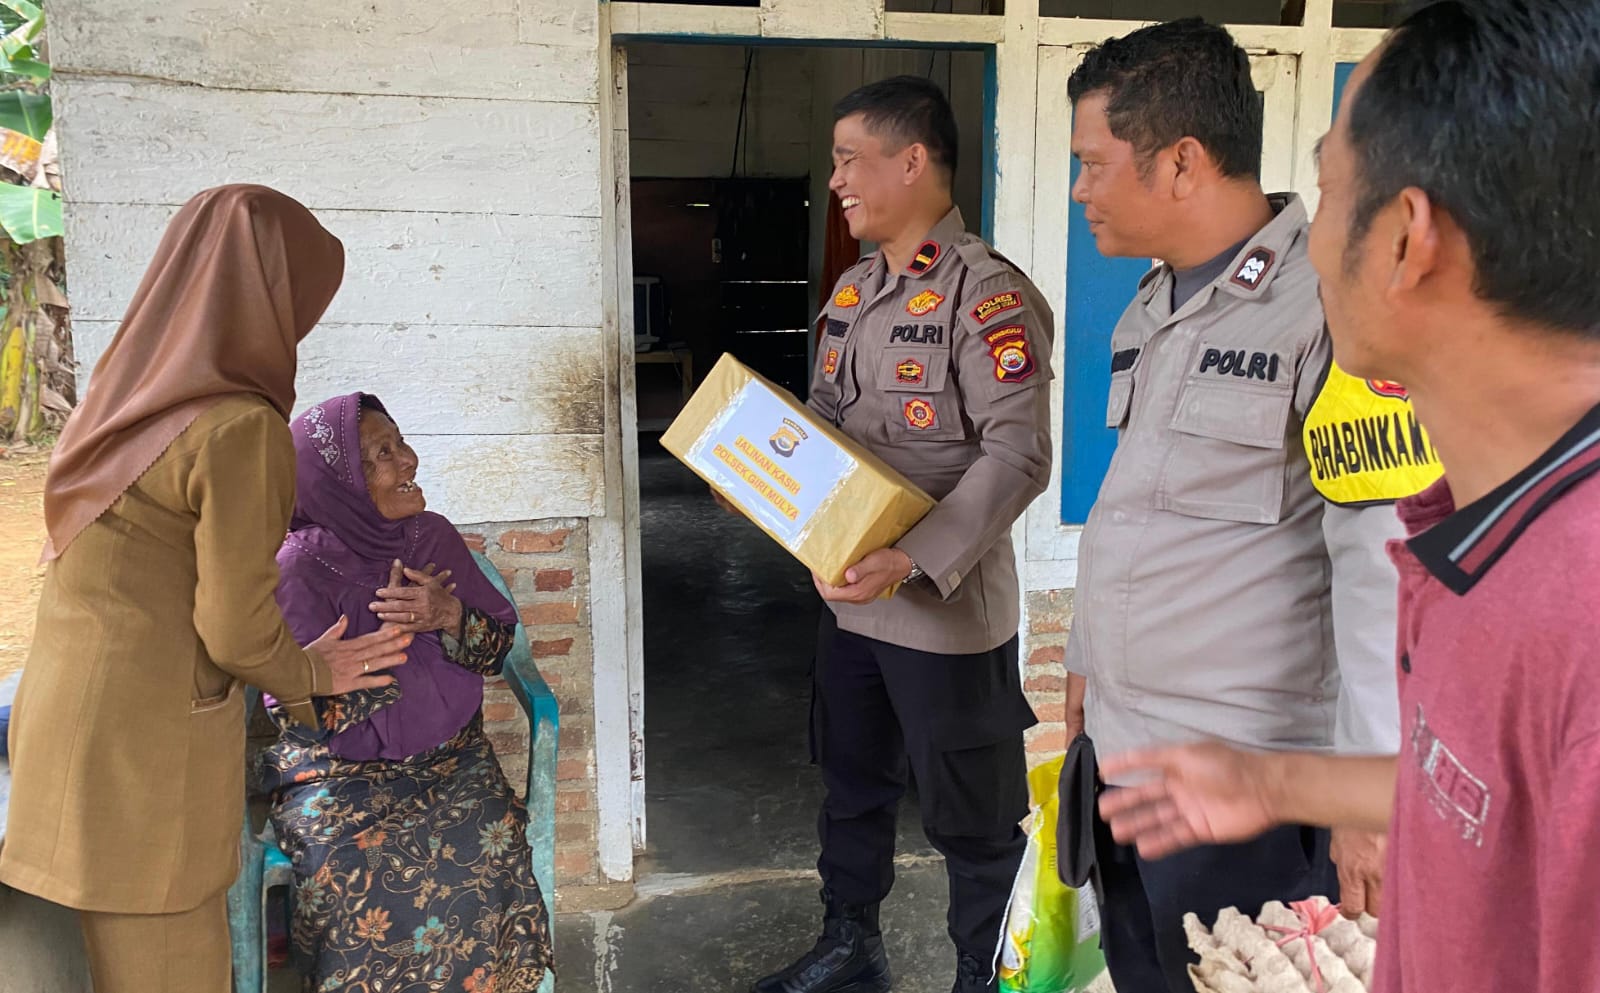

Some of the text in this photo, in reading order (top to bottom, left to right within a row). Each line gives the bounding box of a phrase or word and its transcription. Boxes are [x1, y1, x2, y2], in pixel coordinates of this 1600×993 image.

[977, 294, 1013, 313] POLRES
[889, 324, 944, 345] POLRI
[1199, 348, 1279, 382] POLRI
[734, 438, 801, 495] JALINAN KASIH
[1309, 412, 1437, 480] BHABINKAM
[713, 444, 798, 520] POLSEK GIRI MULYA
